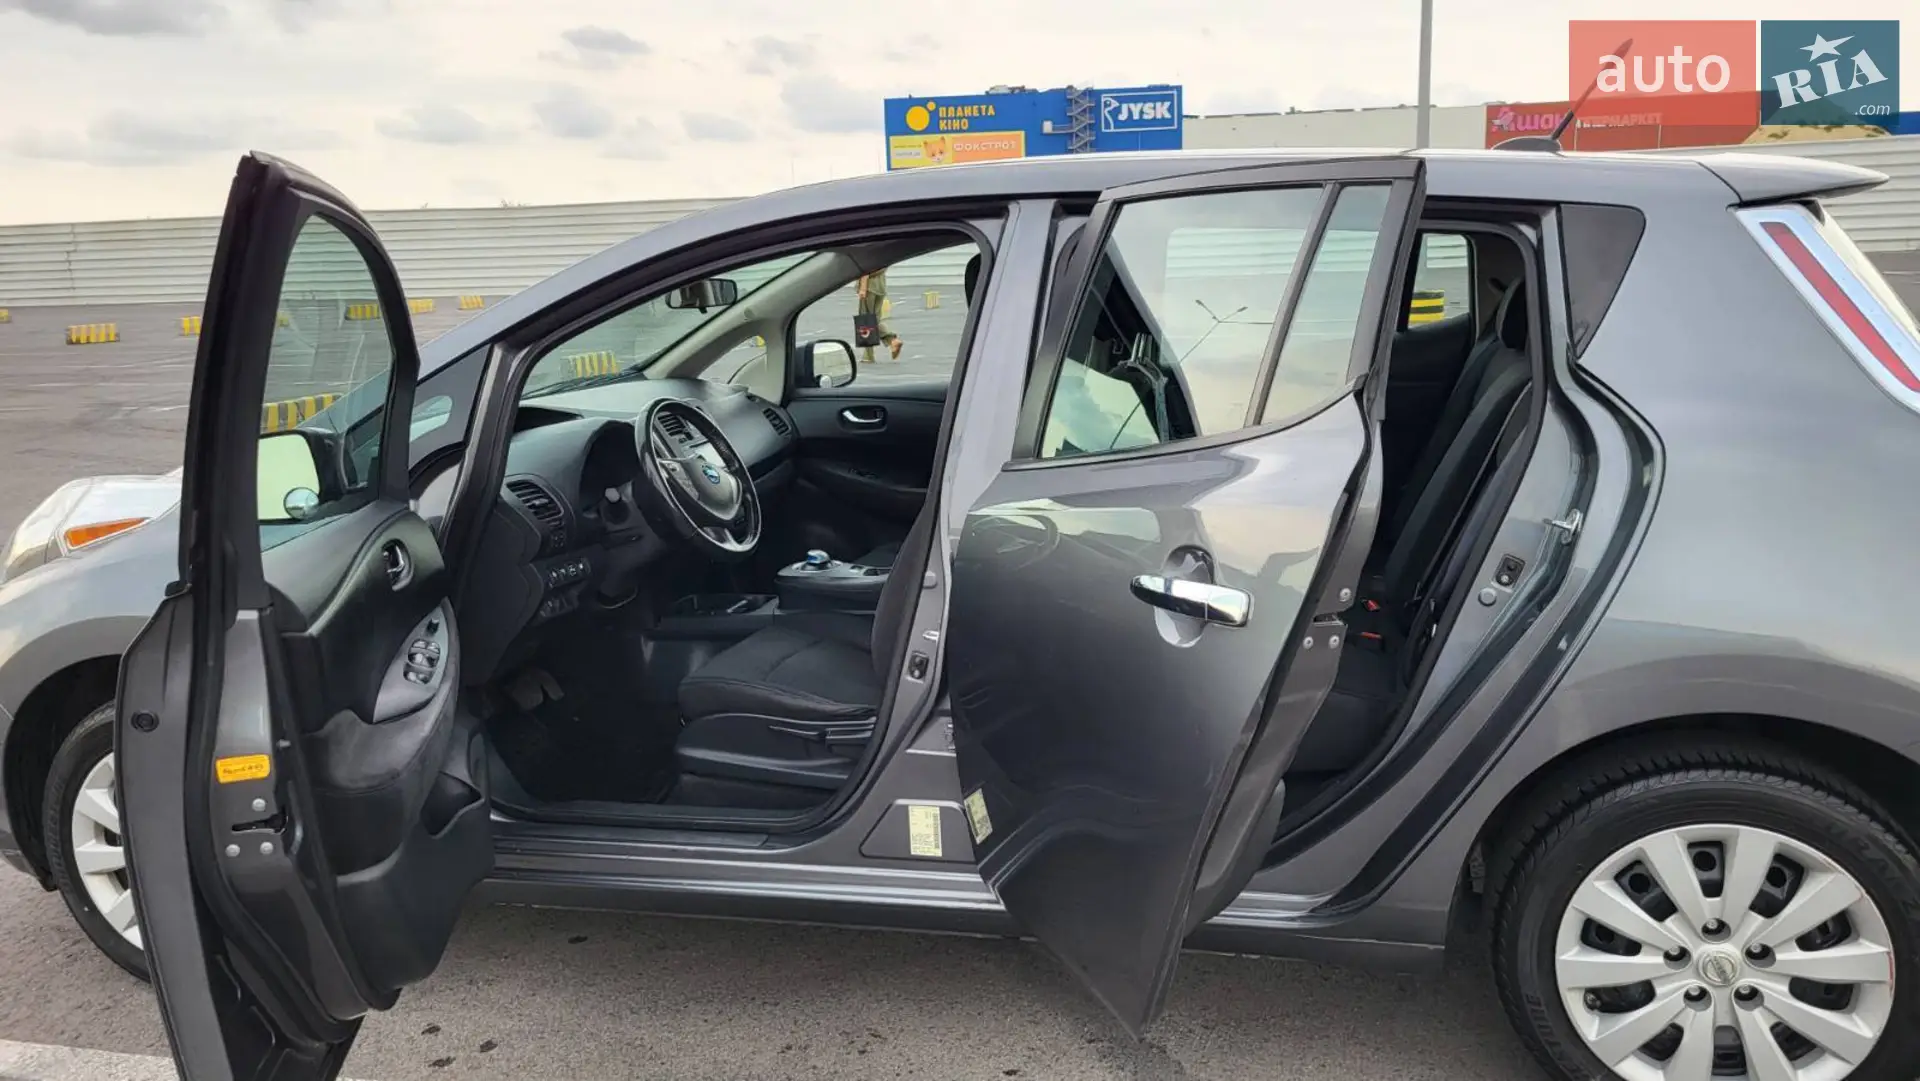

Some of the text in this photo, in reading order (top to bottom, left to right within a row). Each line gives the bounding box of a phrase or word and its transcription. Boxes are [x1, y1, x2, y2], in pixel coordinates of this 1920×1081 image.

[939, 104, 996, 118] ПЛАНЕТА
[1117, 101, 1172, 121] JYSK
[939, 118, 969, 131] КІНО
[953, 140, 1017, 152] ФОКСТРОТ
